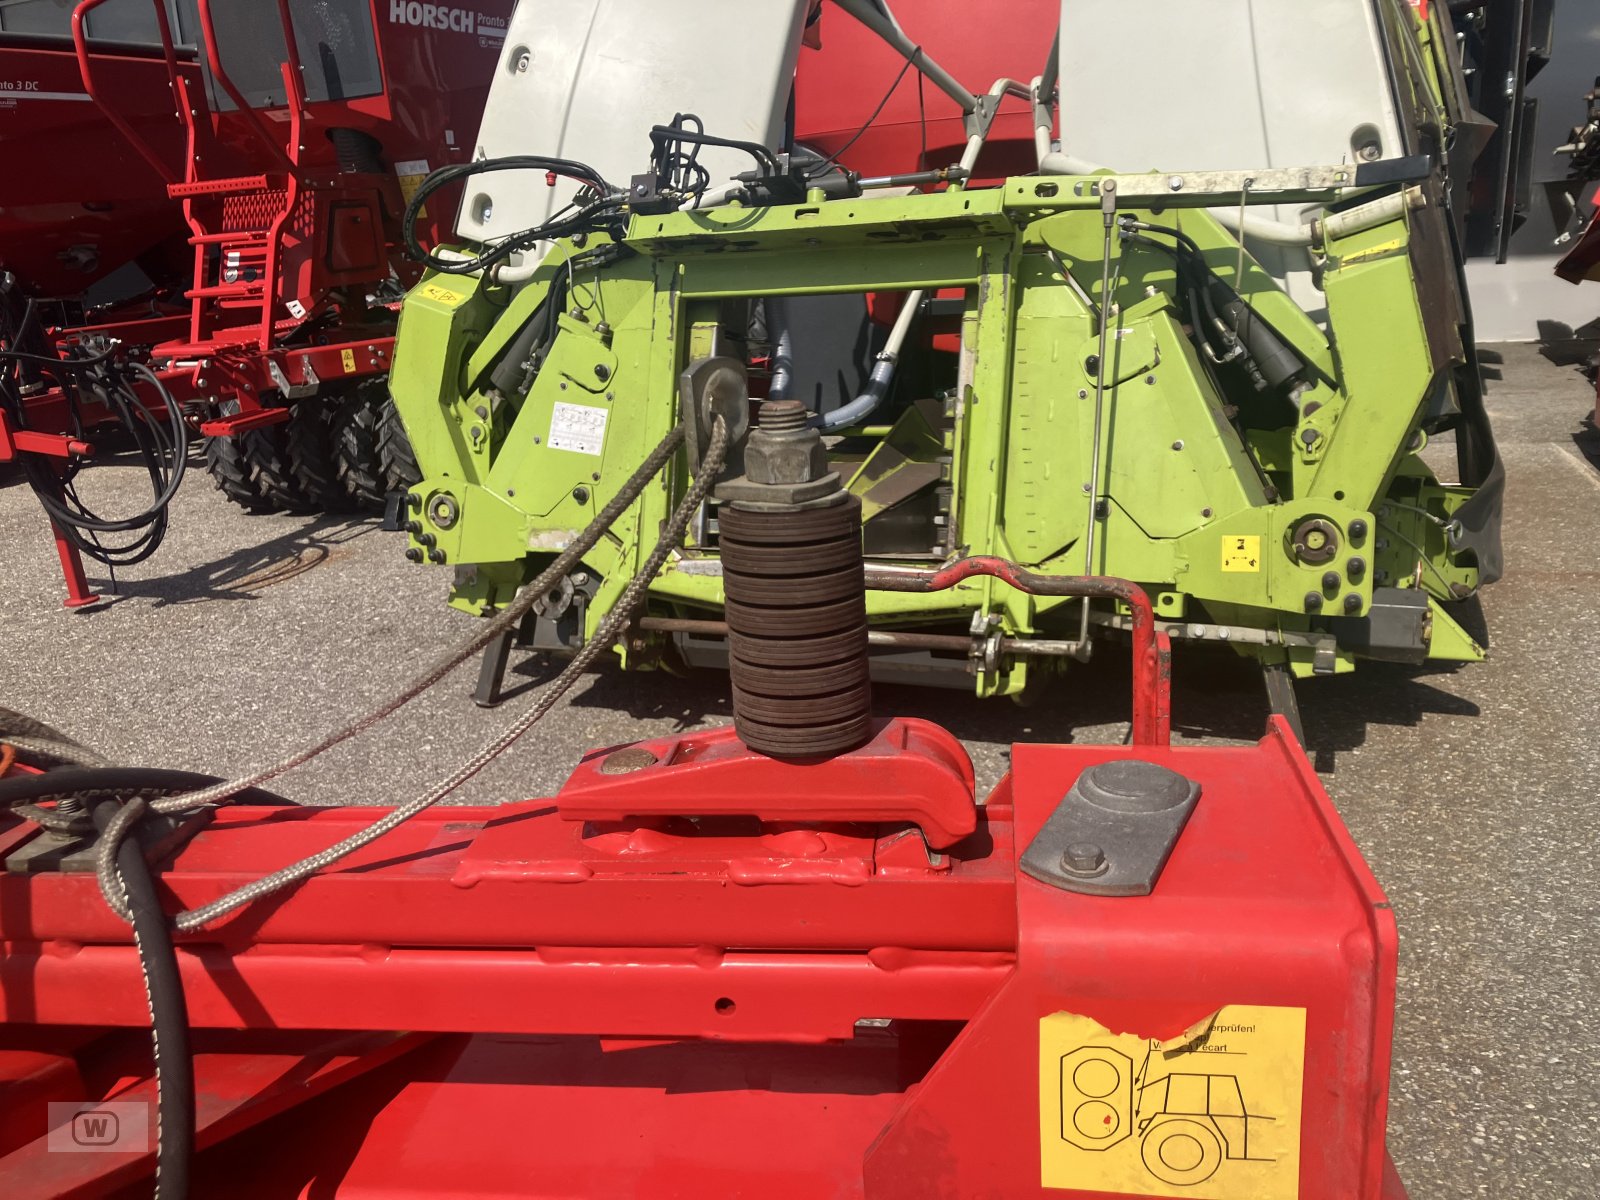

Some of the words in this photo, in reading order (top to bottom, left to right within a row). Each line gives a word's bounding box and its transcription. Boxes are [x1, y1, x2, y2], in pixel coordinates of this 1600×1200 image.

[390, 0, 474, 33] HORSCH
[478, 12, 505, 28] Pronto
[16, 80, 23, 90] 3
[25, 81, 39, 91] DC
